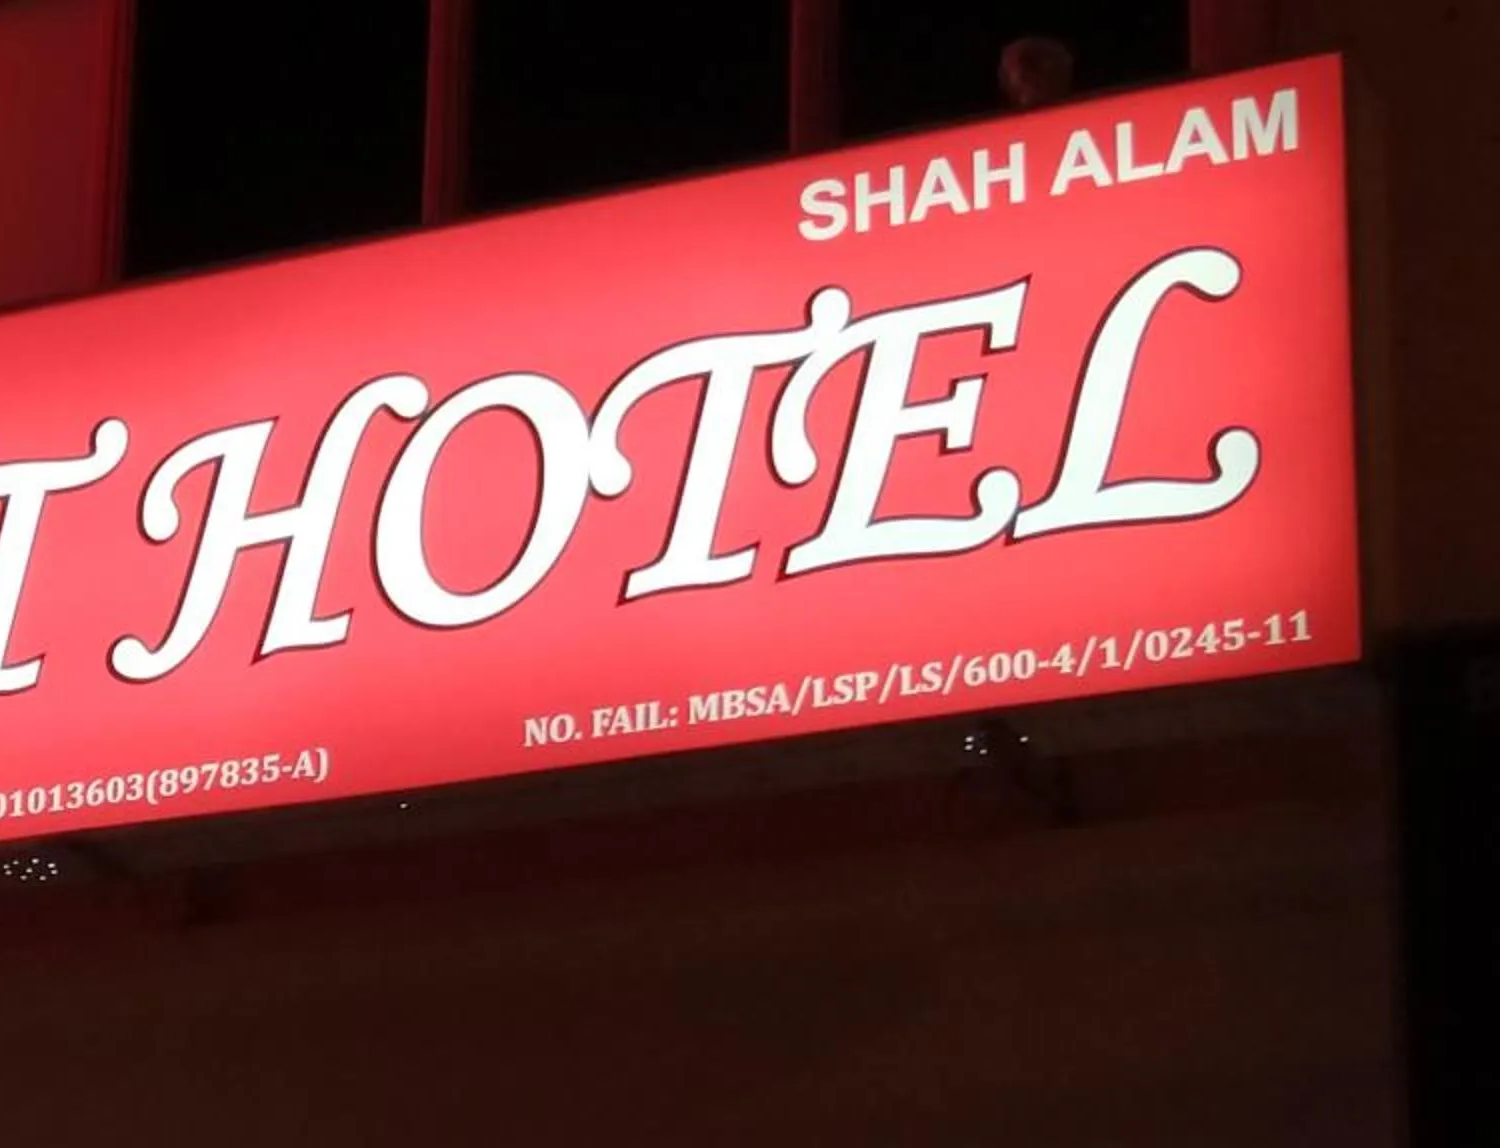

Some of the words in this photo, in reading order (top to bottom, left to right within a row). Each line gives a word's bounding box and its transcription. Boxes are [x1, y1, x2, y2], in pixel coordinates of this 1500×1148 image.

[797, 141, 1027, 241] SHAH
[1049, 88, 1300, 196] ALAM
[107, 246, 1260, 684] HOTEL
[523, 713, 583, 748] NO.
[591, 700, 679, 738] FAIL:
[687, 609, 1313, 727] MBSA/LSP/LS/600-4/1/0245-11
